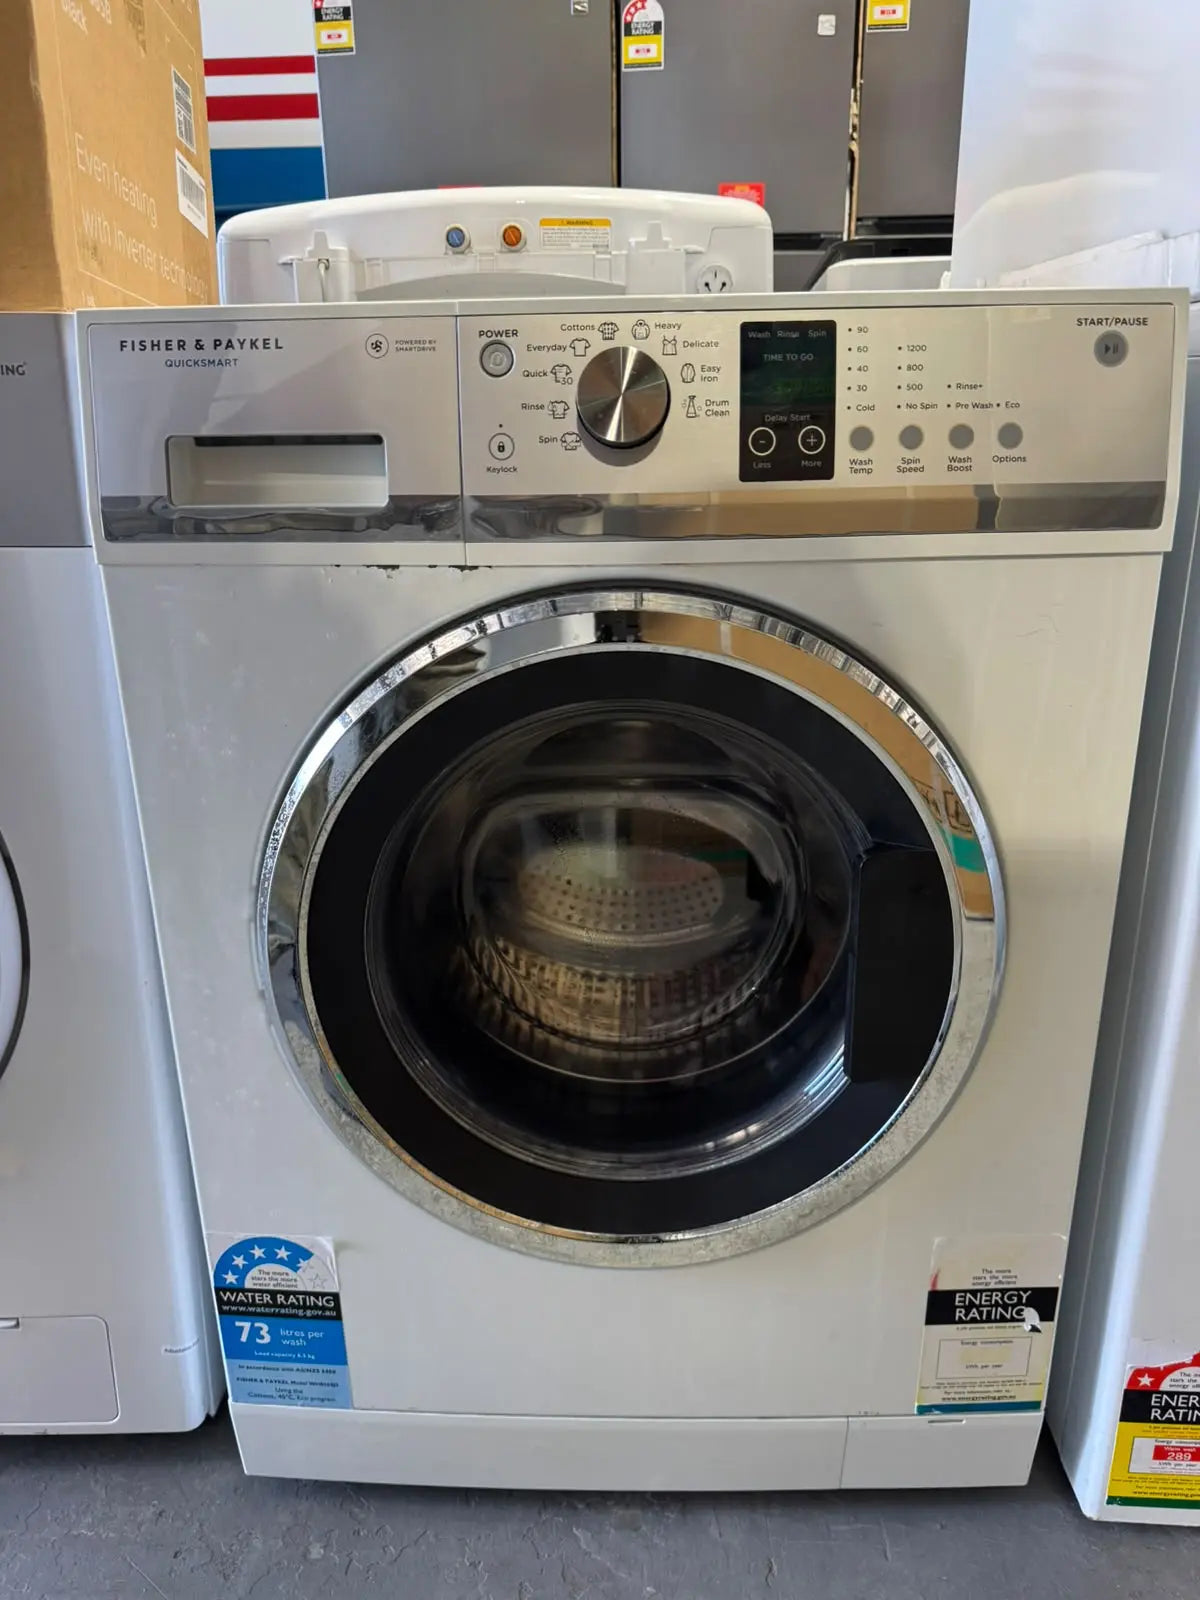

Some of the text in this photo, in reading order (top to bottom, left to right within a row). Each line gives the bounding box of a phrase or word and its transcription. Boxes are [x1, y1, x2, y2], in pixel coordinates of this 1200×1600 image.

[75, 132, 110, 188] Even
[654, 321, 682, 332] Heavy
[1076, 317, 1148, 327] START/PAUSE
[560, 323, 596, 332] Cottons
[857, 326, 868, 334] 90
[478, 329, 519, 339] POWER
[748, 330, 771, 338] Wash
[777, 330, 800, 338] Rinse
[807, 329, 827, 339] Spin
[119, 338, 283, 354] FISHER & PAYKEL
[526, 343, 568, 353] Everyday
[682, 339, 720, 349] Delicate
[763, 353, 814, 361] TIME TO GO
[165, 358, 239, 369] QUICKSMART
[701, 365, 721, 374] Easy
[522, 370, 548, 380] Quick
[701, 374, 719, 382] Iron
[561, 376, 573, 386] 30
[906, 383, 923, 391] 500
[956, 382, 983, 390] Rinse+
[521, 402, 546, 411] Rinse
[705, 399, 730, 407] Drum
[919, 402, 938, 411] Spin
[705, 408, 731, 417] Clean
[856, 404, 876, 412] Cold
[764, 414, 811, 423] Delay Start
[538, 435, 559, 445] Spin
[849, 458, 873, 466] Wash
[901, 457, 920, 466] Spin
[948, 455, 972, 463] Wash
[991, 455, 1027, 464] Options
[753, 461, 771, 469] Less
[801, 460, 822, 468] More
[947, 464, 973, 472] Boost
[486, 465, 519, 475] Keylock
[849, 467, 873, 476] Temp
[896, 465, 925, 475] Speed
[258, 1269, 269, 1277] The
[220, 1290, 336, 1308] WATER RATING
[954, 1290, 1031, 1306] ENERGY
[221, 1304, 337, 1317] www.waterrating.gov.au
[955, 1305, 1027, 1321] RATING
[234, 1321, 325, 1344] 73 litres per
[281, 1339, 307, 1347] wash
[1167, 1452, 1192, 1461] 289
